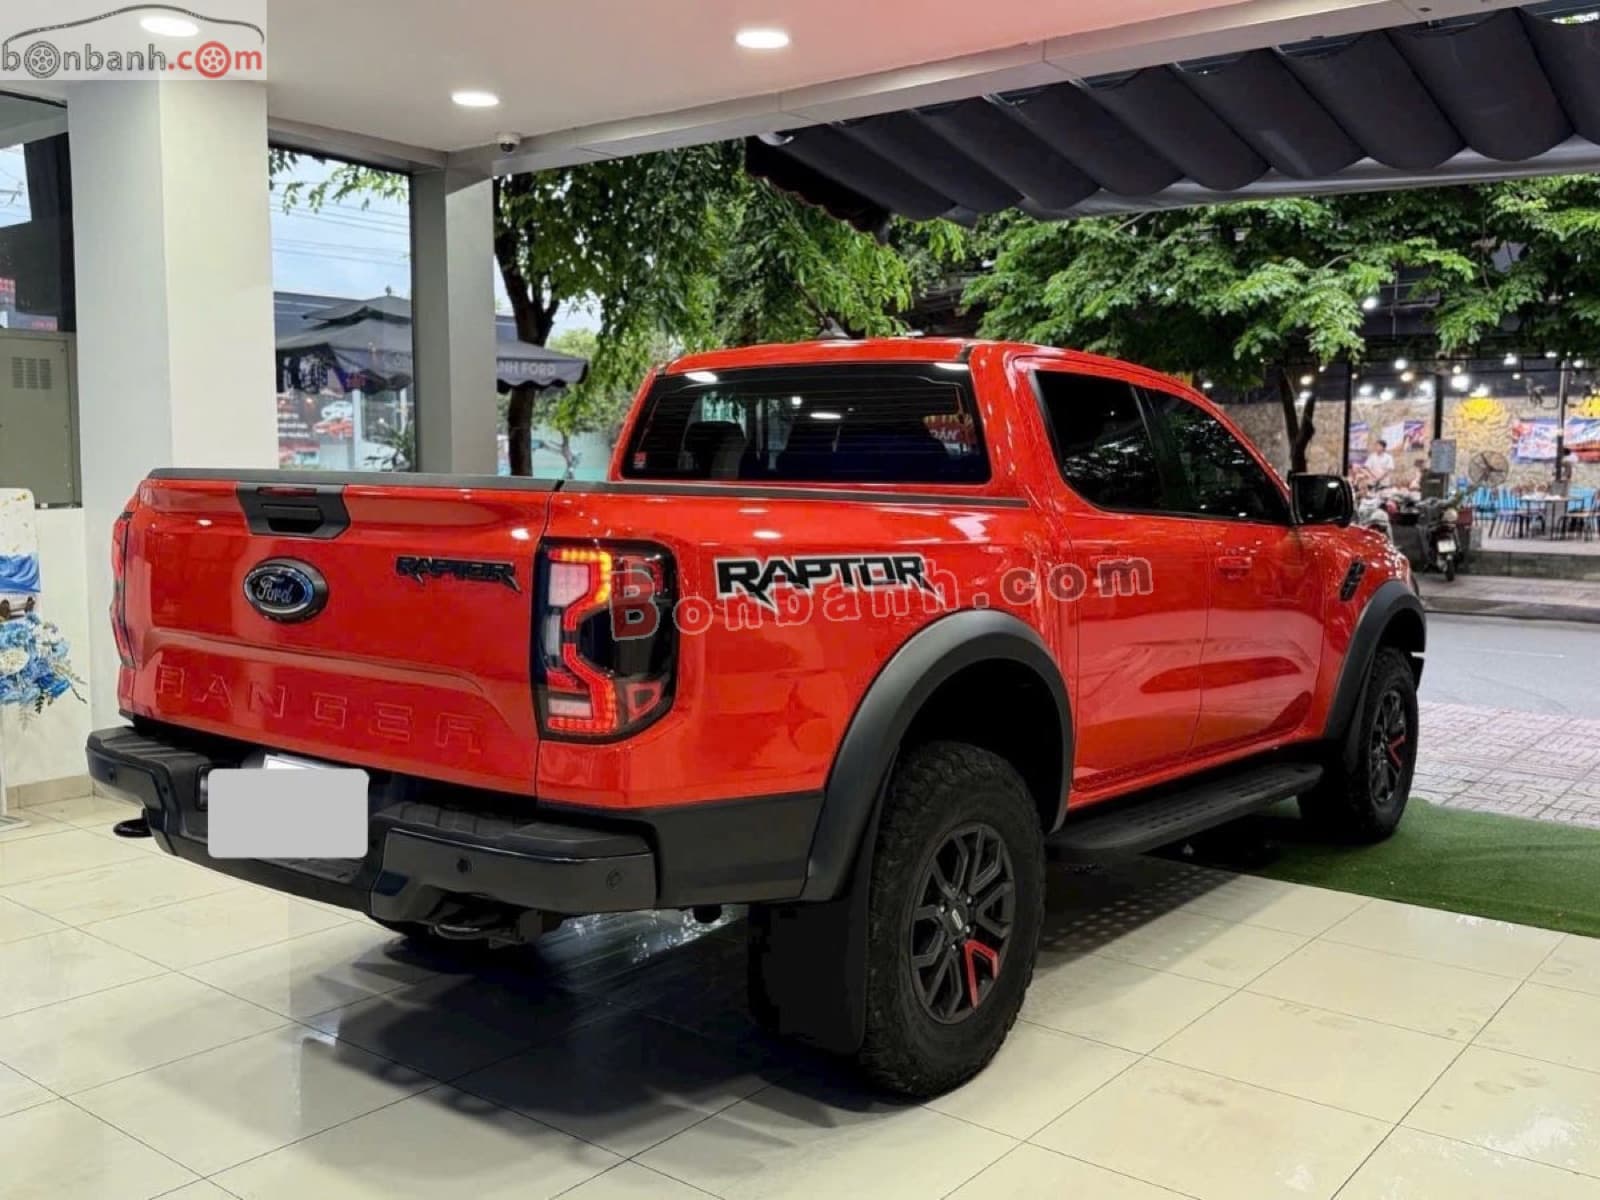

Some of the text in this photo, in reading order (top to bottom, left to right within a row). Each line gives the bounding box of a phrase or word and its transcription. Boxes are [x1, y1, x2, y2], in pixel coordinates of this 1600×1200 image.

[520, 362, 556, 377] FORD
[255, 575, 294, 603] Ford
[714, 553, 945, 616] RAPTOR
[156, 663, 482, 753] RANGER
